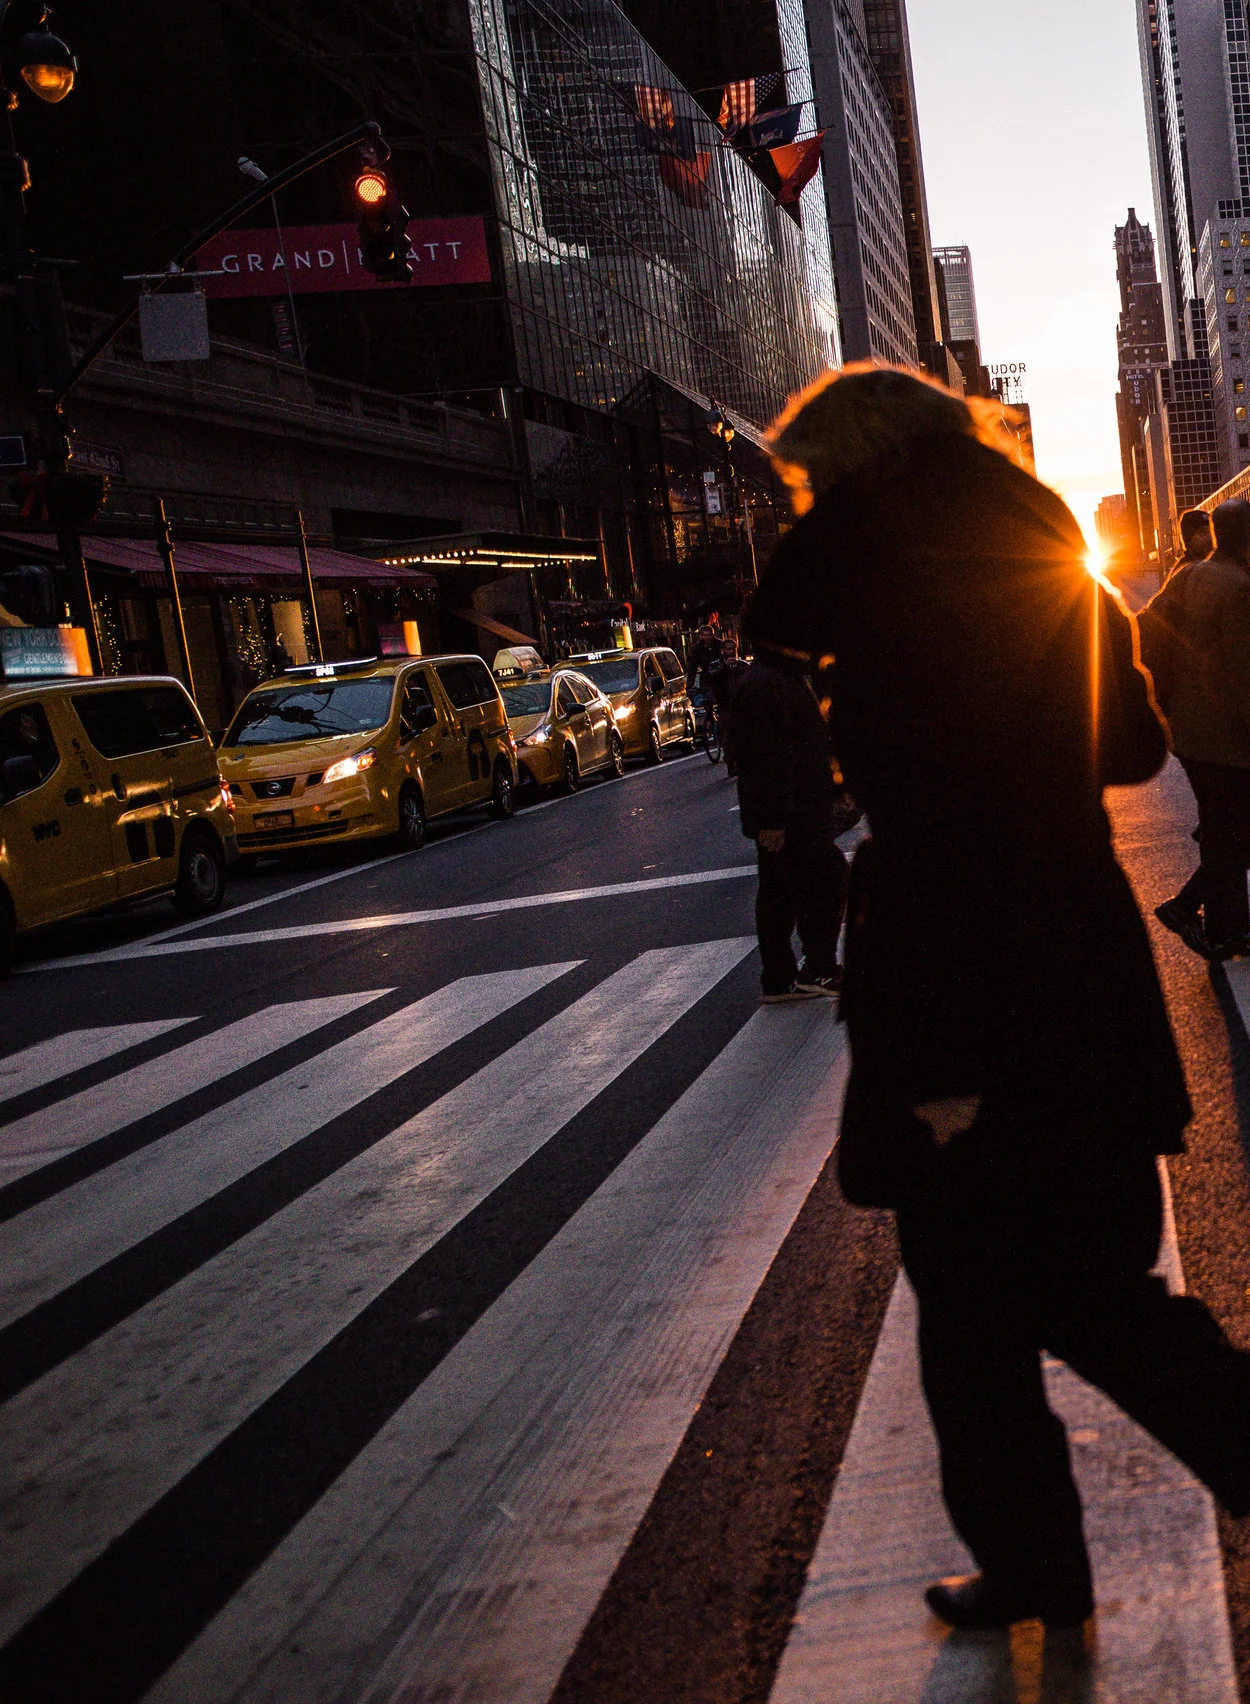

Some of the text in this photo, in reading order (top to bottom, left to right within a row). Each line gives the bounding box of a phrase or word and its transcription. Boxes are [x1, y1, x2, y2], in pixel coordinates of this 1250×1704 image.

[221, 240, 462, 273] GRAND ATT
[986, 362, 1027, 375] UDOR
[991, 375, 1021, 388] CTY
[31, 819, 61, 842] NYC
